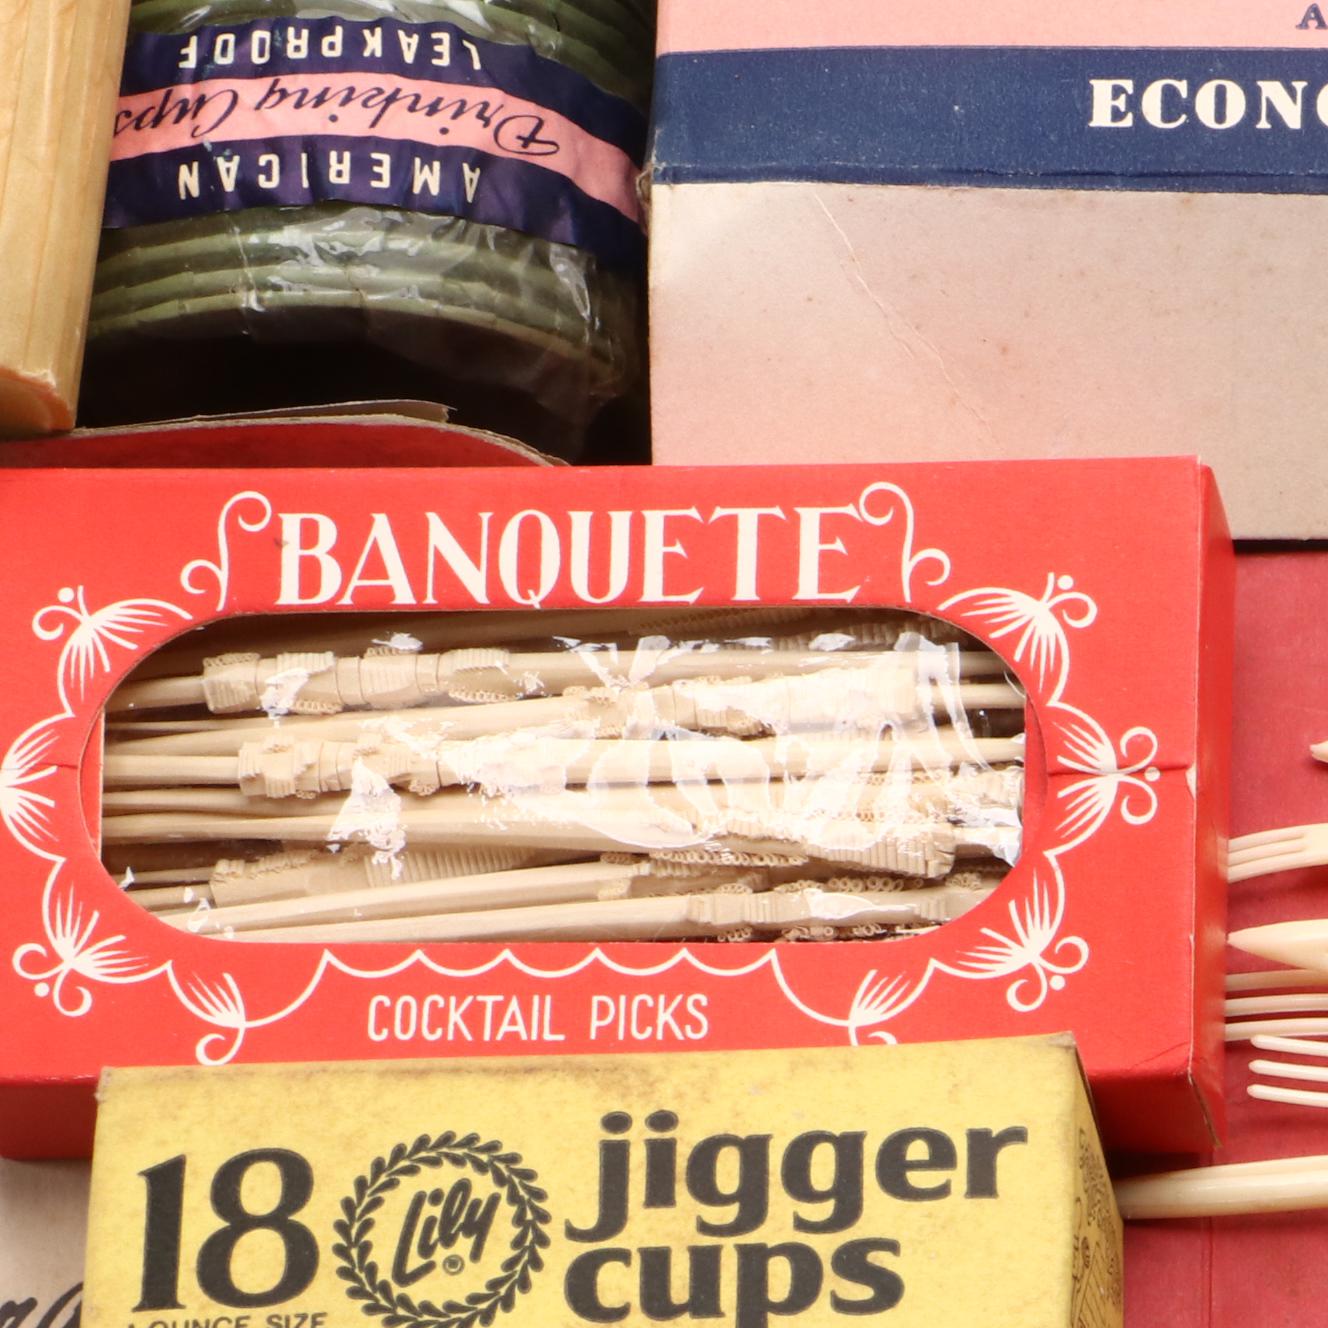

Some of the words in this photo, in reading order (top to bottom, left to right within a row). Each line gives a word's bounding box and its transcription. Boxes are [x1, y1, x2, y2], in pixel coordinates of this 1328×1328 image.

[179, 28, 481, 70] LEAKPROOF
[112, 87, 239, 139] Cups
[253, 77, 561, 157] Drinking
[178, 149, 482, 204] AMERICAN
[274, 500, 863, 609] BANQUETE
[366, 994, 566, 1042] COCKTAIL
[588, 992, 710, 1041] PICKS
[563, 1109, 1028, 1243] jigger
[131, 1147, 319, 1313] 18
[391, 1177, 502, 1289] Lily
